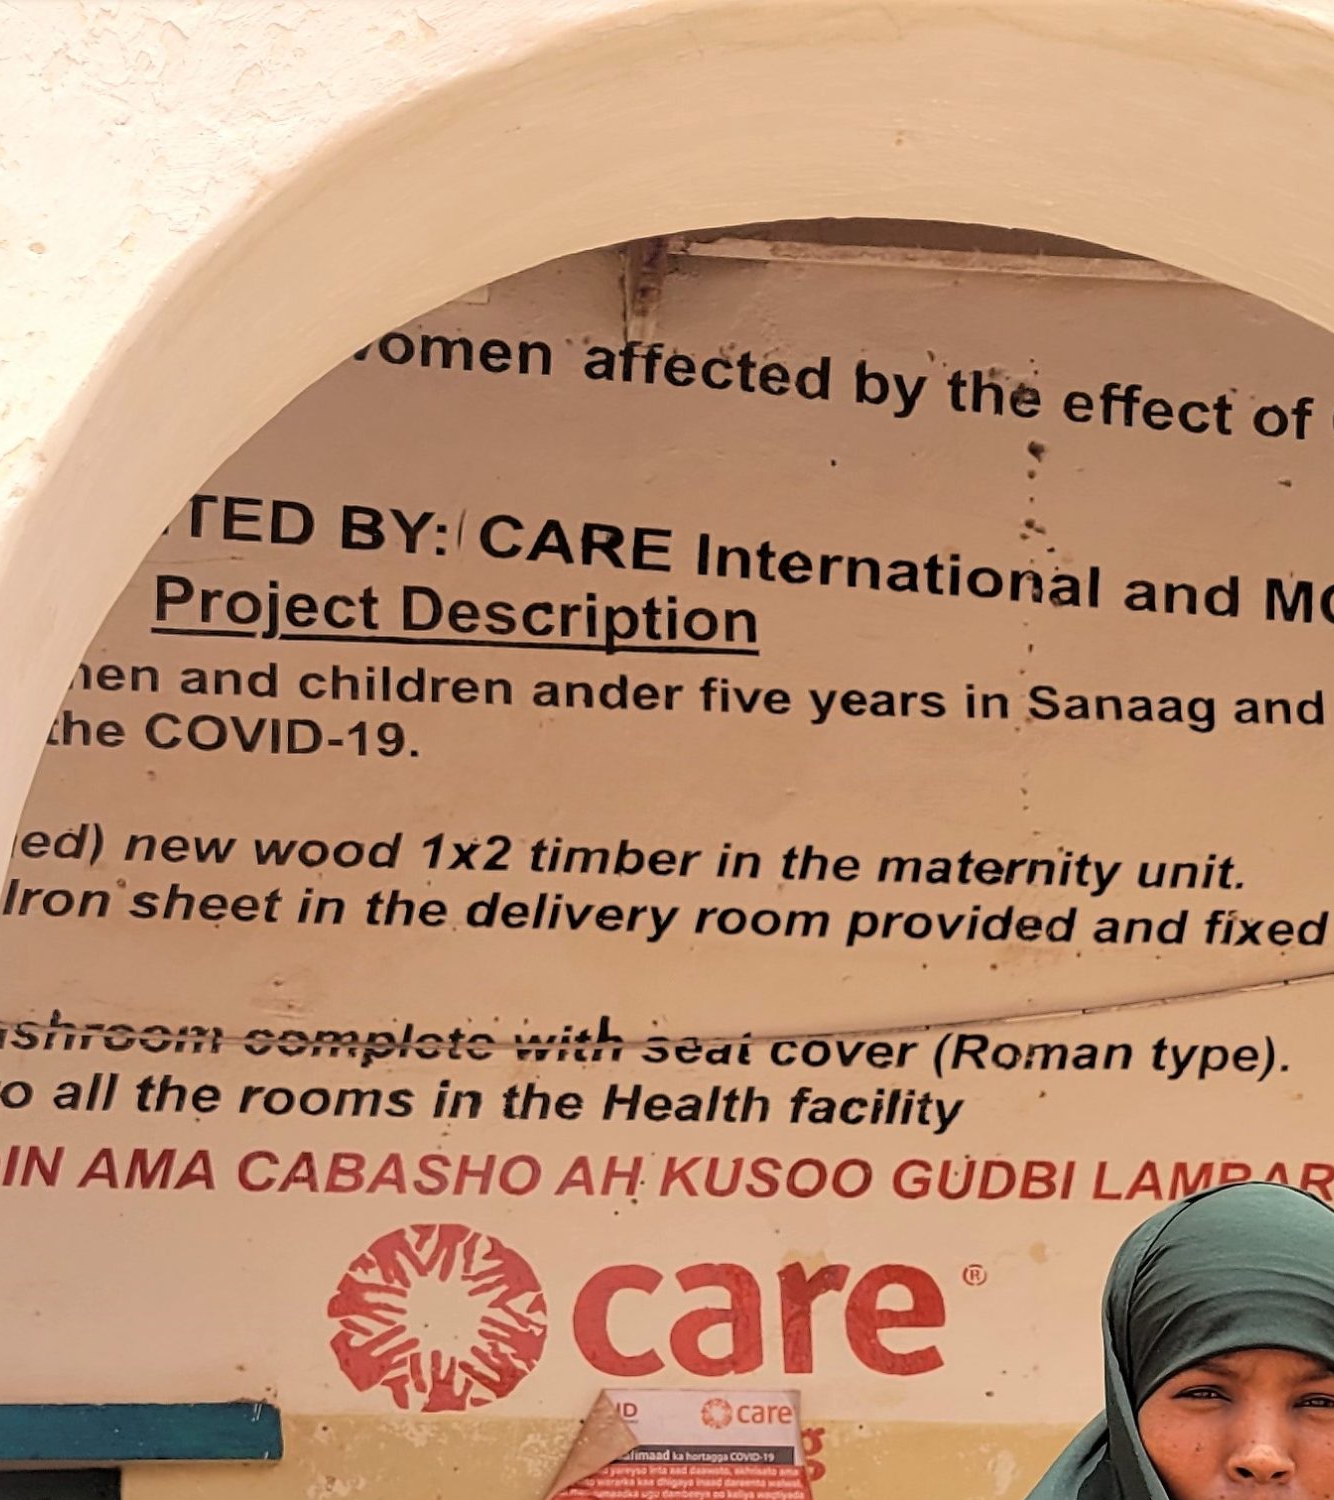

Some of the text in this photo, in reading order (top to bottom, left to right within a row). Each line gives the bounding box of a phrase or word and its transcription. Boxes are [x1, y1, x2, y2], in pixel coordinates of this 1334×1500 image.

[354, 332, 551, 375] omen
[584, 341, 830, 399] affected
[855, 361, 927, 418] by
[948, 371, 1041, 418] the
[1064, 383, 1232, 436] effect
[1253, 397, 1312, 440] of
[163, 494, 314, 545] TED
[341, 505, 447, 555] BY:
[481, 515, 672, 572] CARE
[698, 533, 1100, 608] International
[1124, 577, 1240, 618] and
[155, 575, 759, 654] Project Description
[180, 662, 278, 698] and
[299, 665, 513, 706] children
[533, 674, 683, 712] ander
[700, 677, 791, 716] five
[809, 684, 946, 726] years
[965, 683, 1009, 720] in
[1028, 685, 1216, 733] Sanaag
[1234, 689, 1325, 727] and
[145, 711, 419, 758] COVID-19.
[11, 823, 1244, 896] ed) new wood 1x2 timber in the maternity unit.
[3, 880, 111, 916] Iron
[129, 883, 281, 923] sheet
[298, 888, 345, 924] in
[365, 889, 447, 926] the
[467, 892, 679, 942] delivery
[695, 905, 830, 939] room
[847, 905, 1077, 947] provided
[1093, 911, 1187, 945] and
[1205, 910, 1329, 948] fixed
[242, 1023, 496, 1068] complete
[514, 1015, 624, 1062] with
[641, 1035, 751, 1066] seat
[770, 1037, 918, 1069] cover
[934, 1033, 1133, 1079] (Roman
[1151, 1035, 1291, 1081] type).
[53, 1073, 119, 1111] all
[136, 1074, 221, 1113] the
[239, 1084, 415, 1118] rooms
[433, 1079, 483, 1119] in
[503, 1083, 584, 1120] the
[603, 1084, 768, 1122] Health
[790, 1089, 964, 1135] facility
[77, 1147, 216, 1191] AMA
[237, 1150, 542, 1197] CABASHO
[556, 1155, 643, 1197] AH
[660, 1156, 872, 1200] KUSOO
[892, 1158, 1075, 1201] GUDBI
[573, 1263, 946, 1377] care
[737, 1404, 793, 1424] care
[730, 1452, 775, 1462] COVID-19
